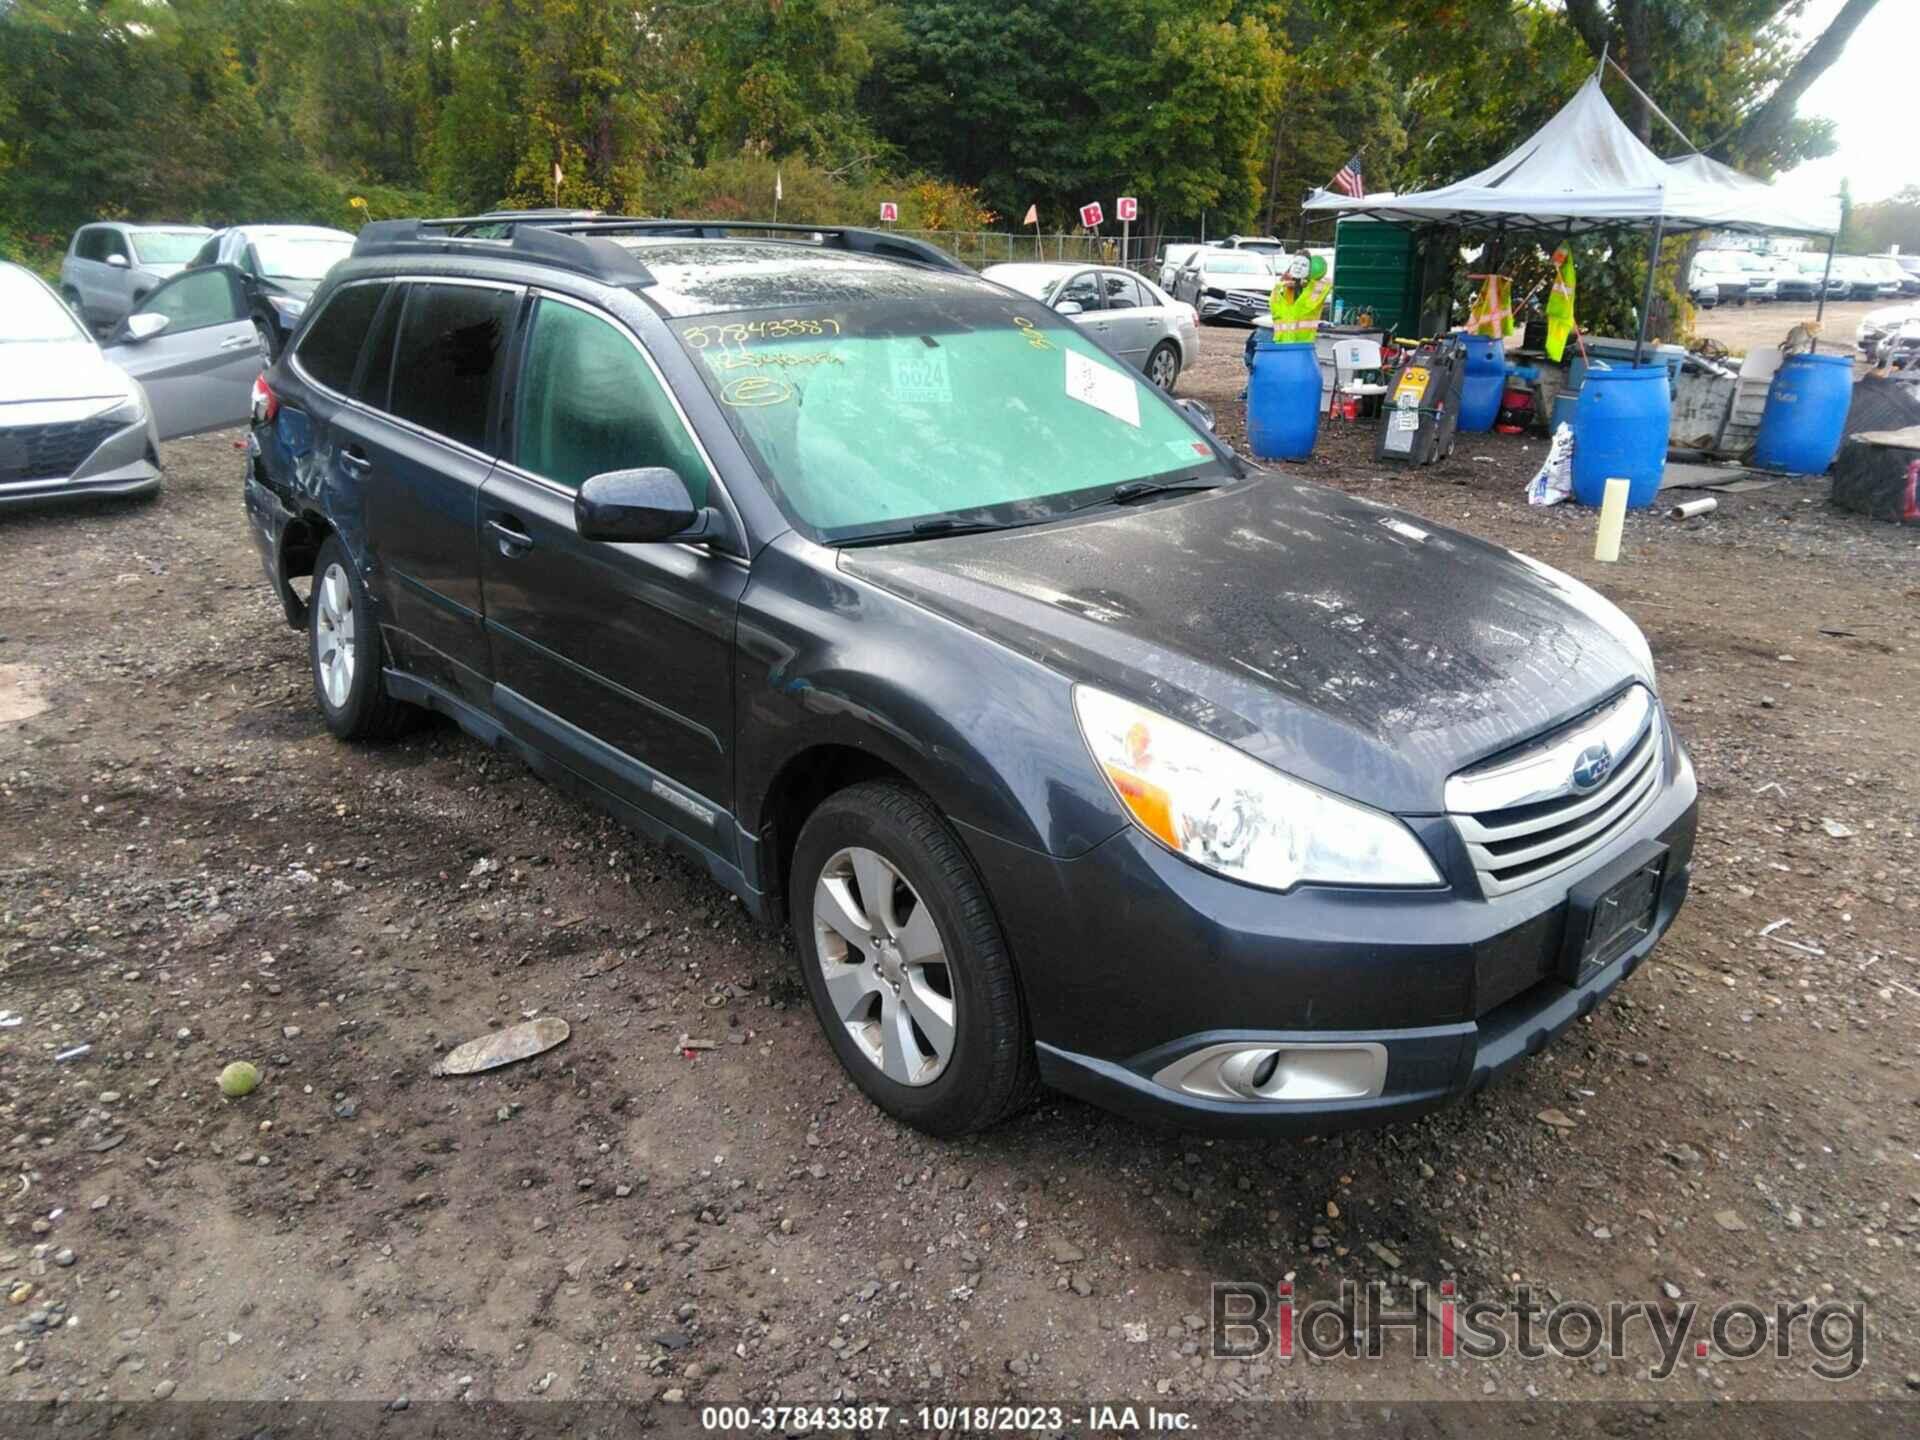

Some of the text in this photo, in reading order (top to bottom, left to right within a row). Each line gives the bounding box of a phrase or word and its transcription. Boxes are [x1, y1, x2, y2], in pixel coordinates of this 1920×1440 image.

[882, 204, 896, 219] A
[1083, 206, 1101, 225] B
[1120, 199, 1136, 218] C
[683, 319, 840, 350] 37843387
